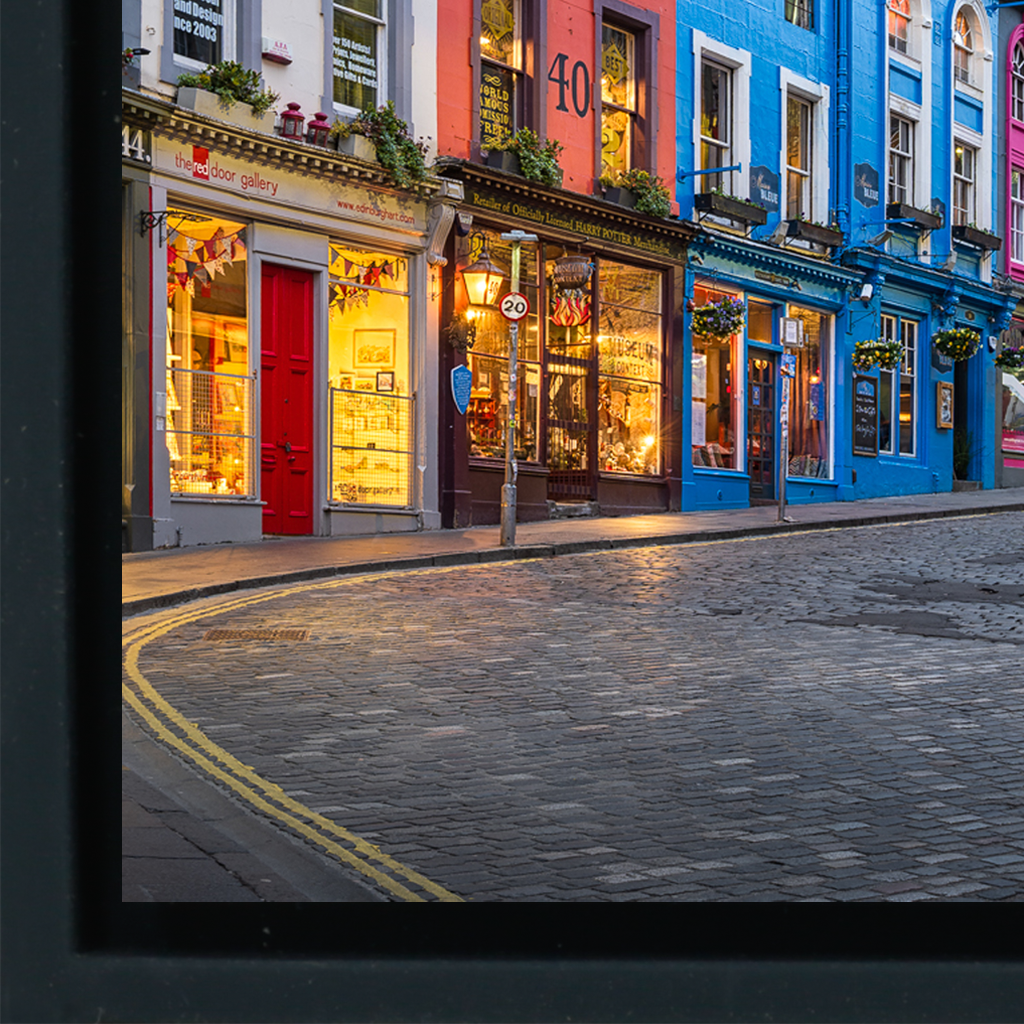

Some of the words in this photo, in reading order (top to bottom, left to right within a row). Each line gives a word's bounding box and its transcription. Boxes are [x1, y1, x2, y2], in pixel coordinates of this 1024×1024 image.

[193, 1, 224, 26] Design
[193, 21, 217, 42] 2003
[605, 55, 624, 73] BEST
[548, 52, 590, 118] 40
[175, 152, 192, 171] the
[193, 159, 208, 175] red
[211, 161, 236, 182] door
[241, 172, 278, 196] gallery
[473, 192, 501, 210] Retailer
[502, 202, 511, 213] of
[512, 204, 545, 224] Officially
[575, 220, 601, 236] HARRY
[602, 228, 632, 245] POTTER
[503, 299, 526, 314] 20
